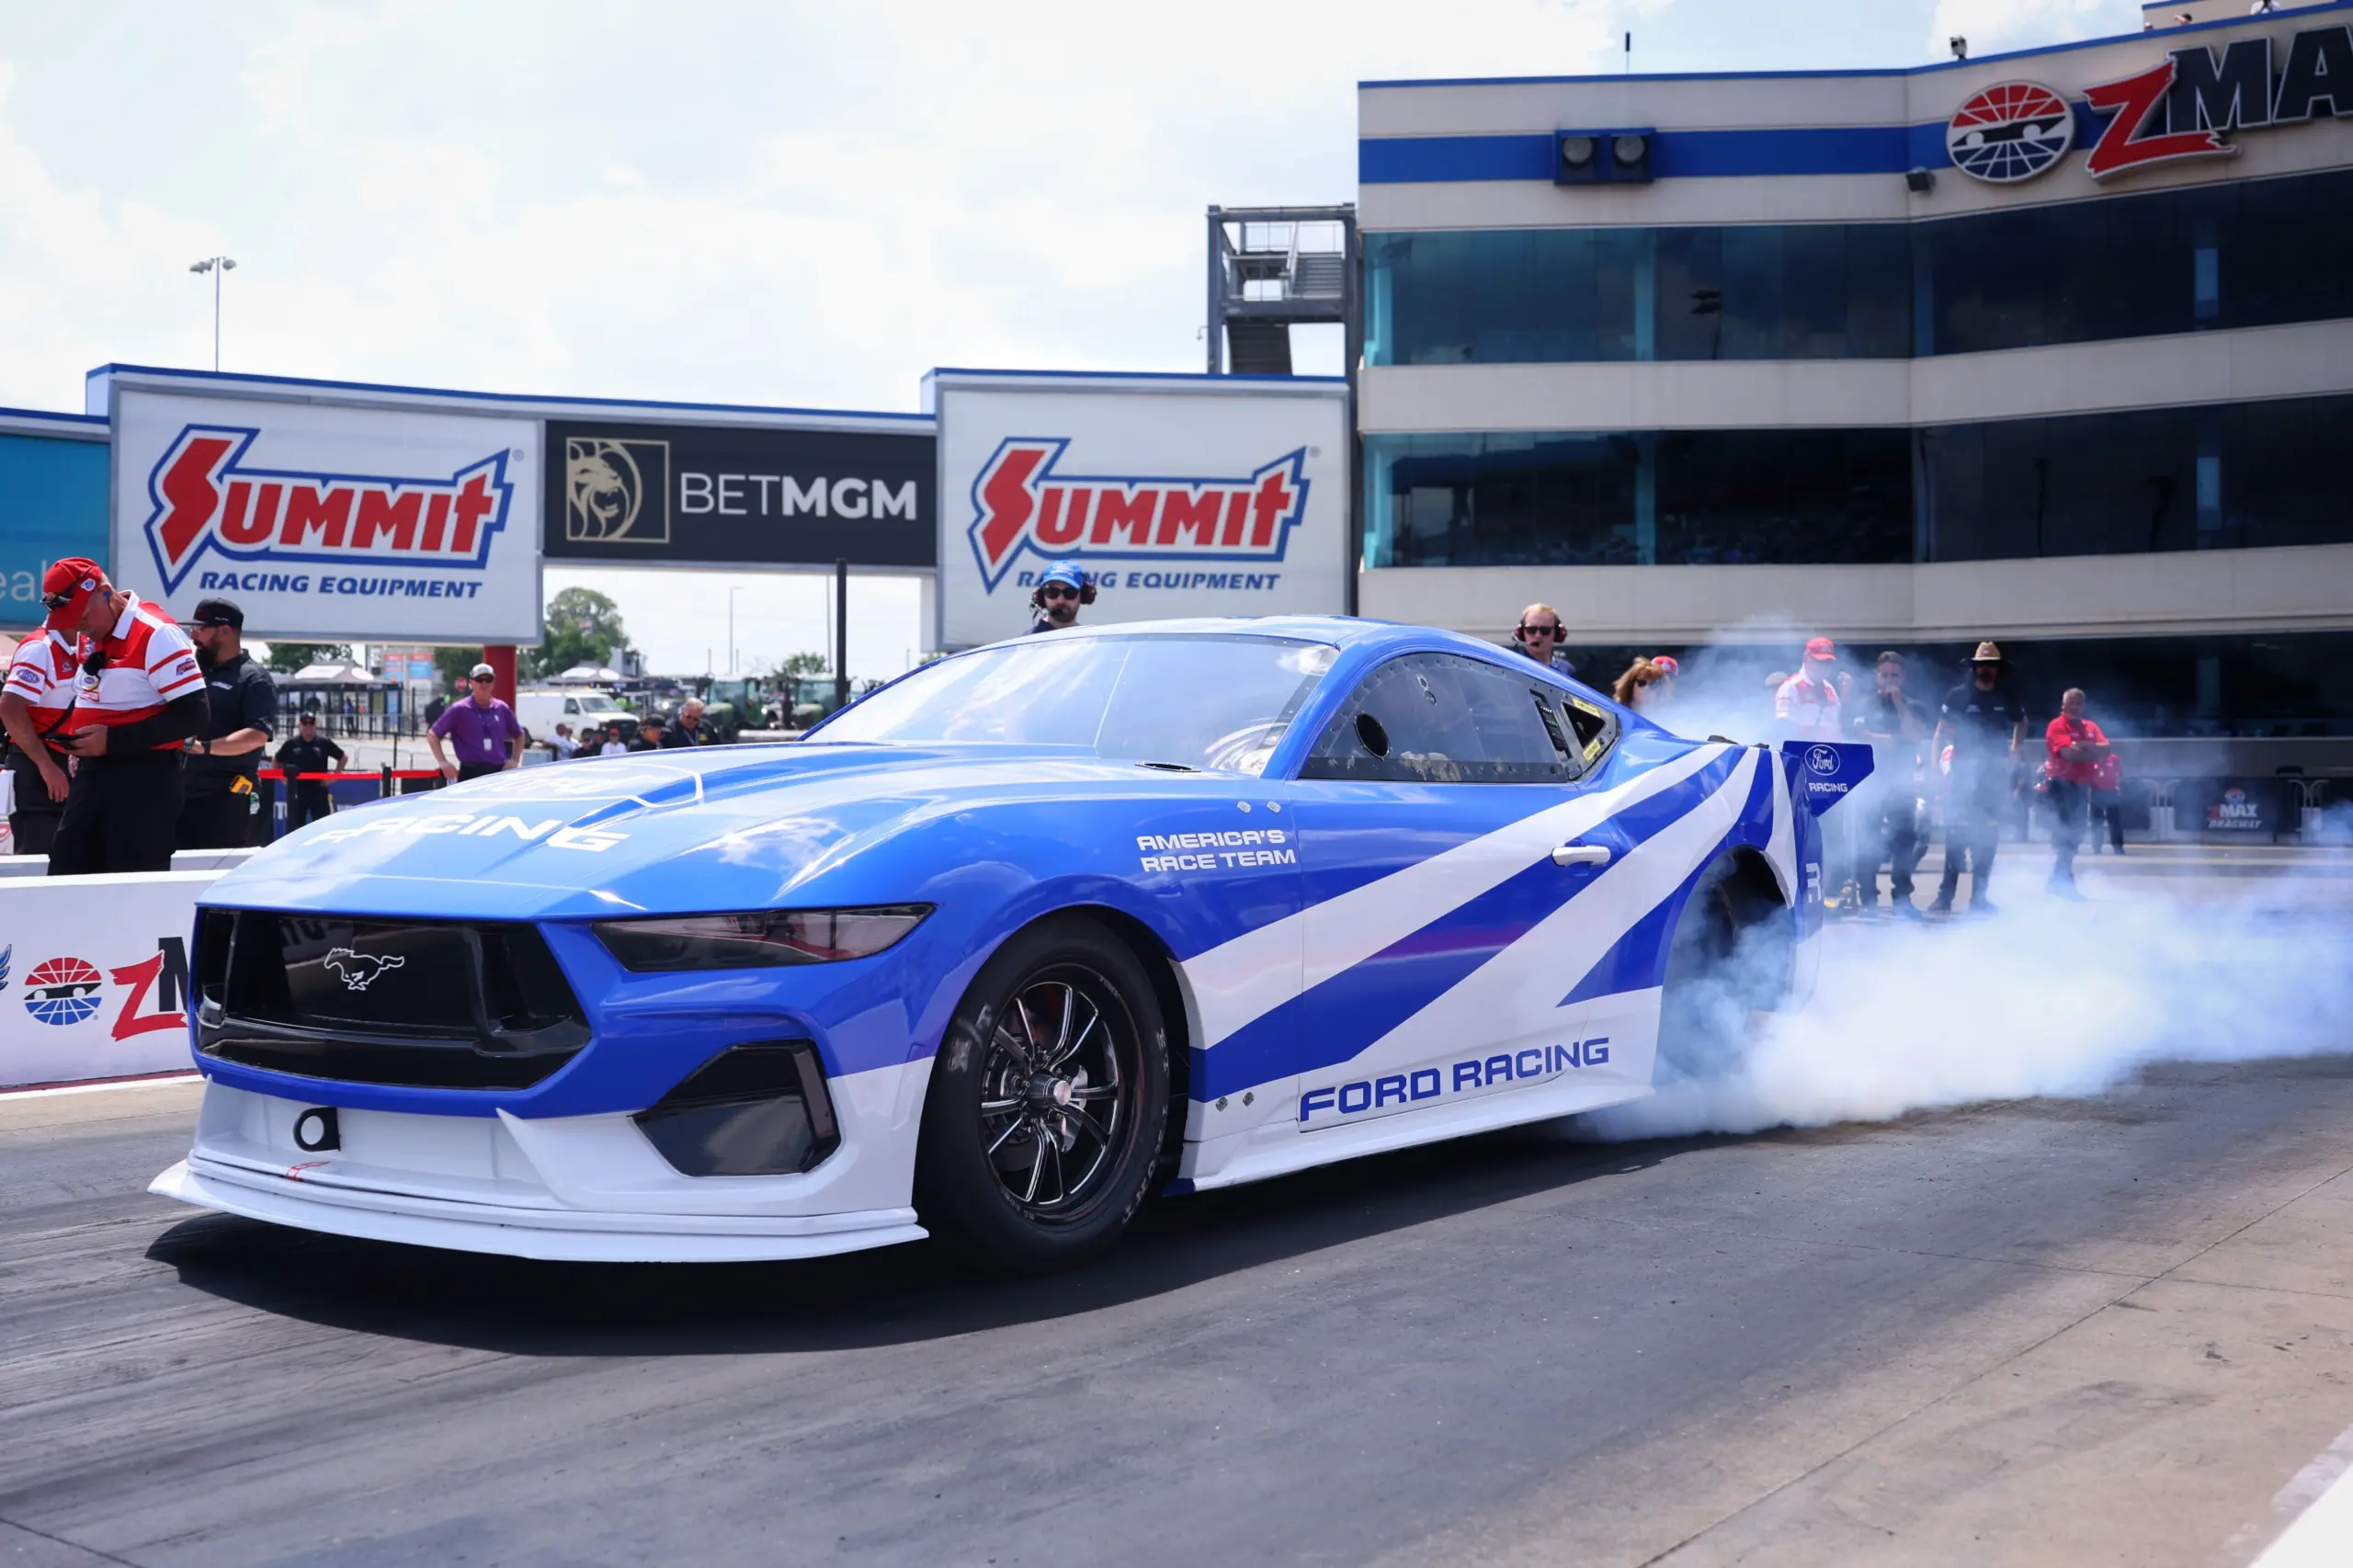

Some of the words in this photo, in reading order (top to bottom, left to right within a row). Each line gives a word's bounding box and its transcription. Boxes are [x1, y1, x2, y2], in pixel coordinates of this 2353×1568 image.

[680, 472, 916, 520] BETMGM
[199, 572, 309, 594] RACING
[318, 577, 483, 598] EQUIPMENT
[1126, 572, 1280, 590] EQUIPMENT
[1808, 782, 1848, 792] RACING
[300, 814, 631, 853] RACING
[1136, 829, 1286, 851] AMERICA'S
[1140, 853, 1217, 872] RACE
[1219, 849, 1297, 868] TEAM
[1300, 1068, 1440, 1123] FORD
[1453, 1037, 1609, 1094] RACING
